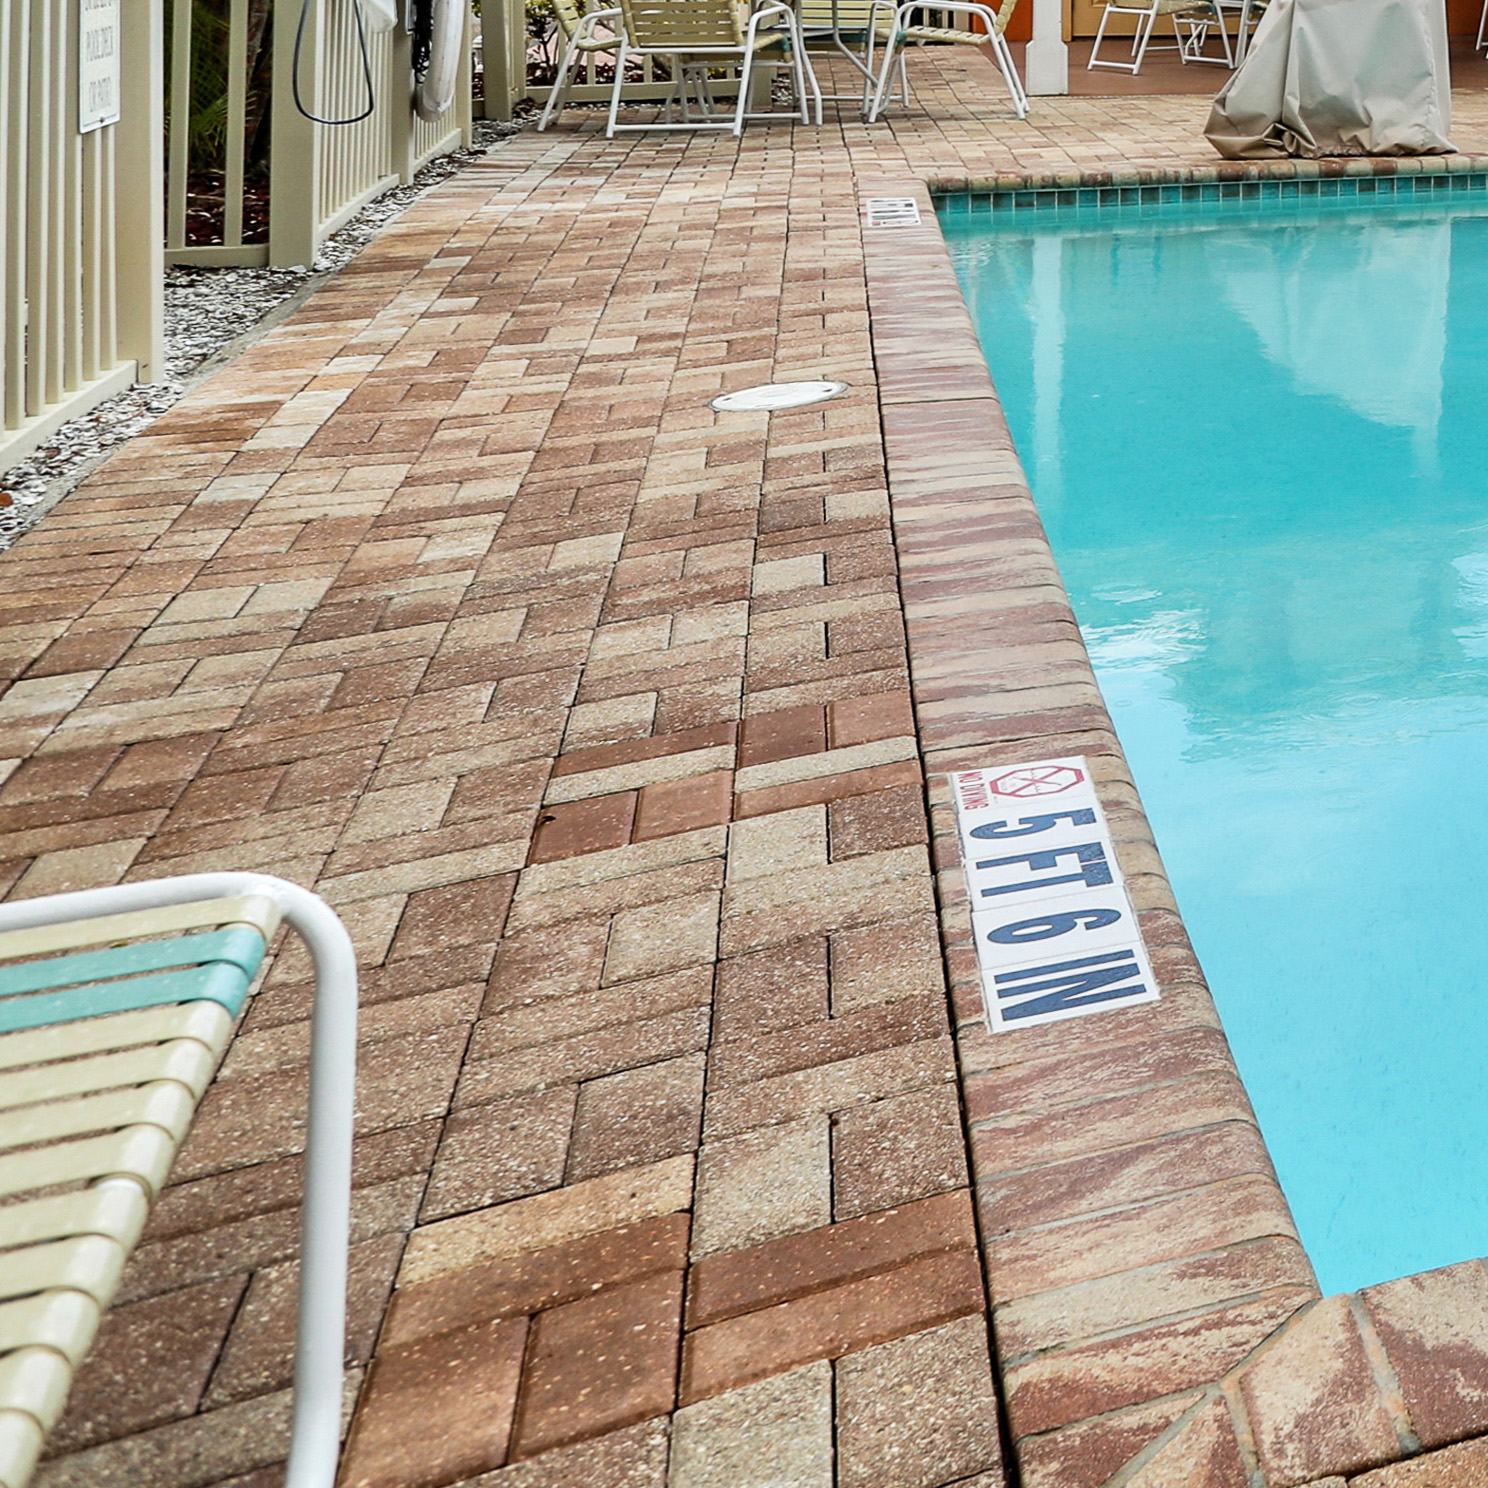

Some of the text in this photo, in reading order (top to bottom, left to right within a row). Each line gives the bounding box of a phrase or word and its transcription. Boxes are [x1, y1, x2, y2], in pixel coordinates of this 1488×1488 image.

[957, 771, 989, 810] NO DIVING
[969, 807, 1147, 1022] 5 FT 6 IN
